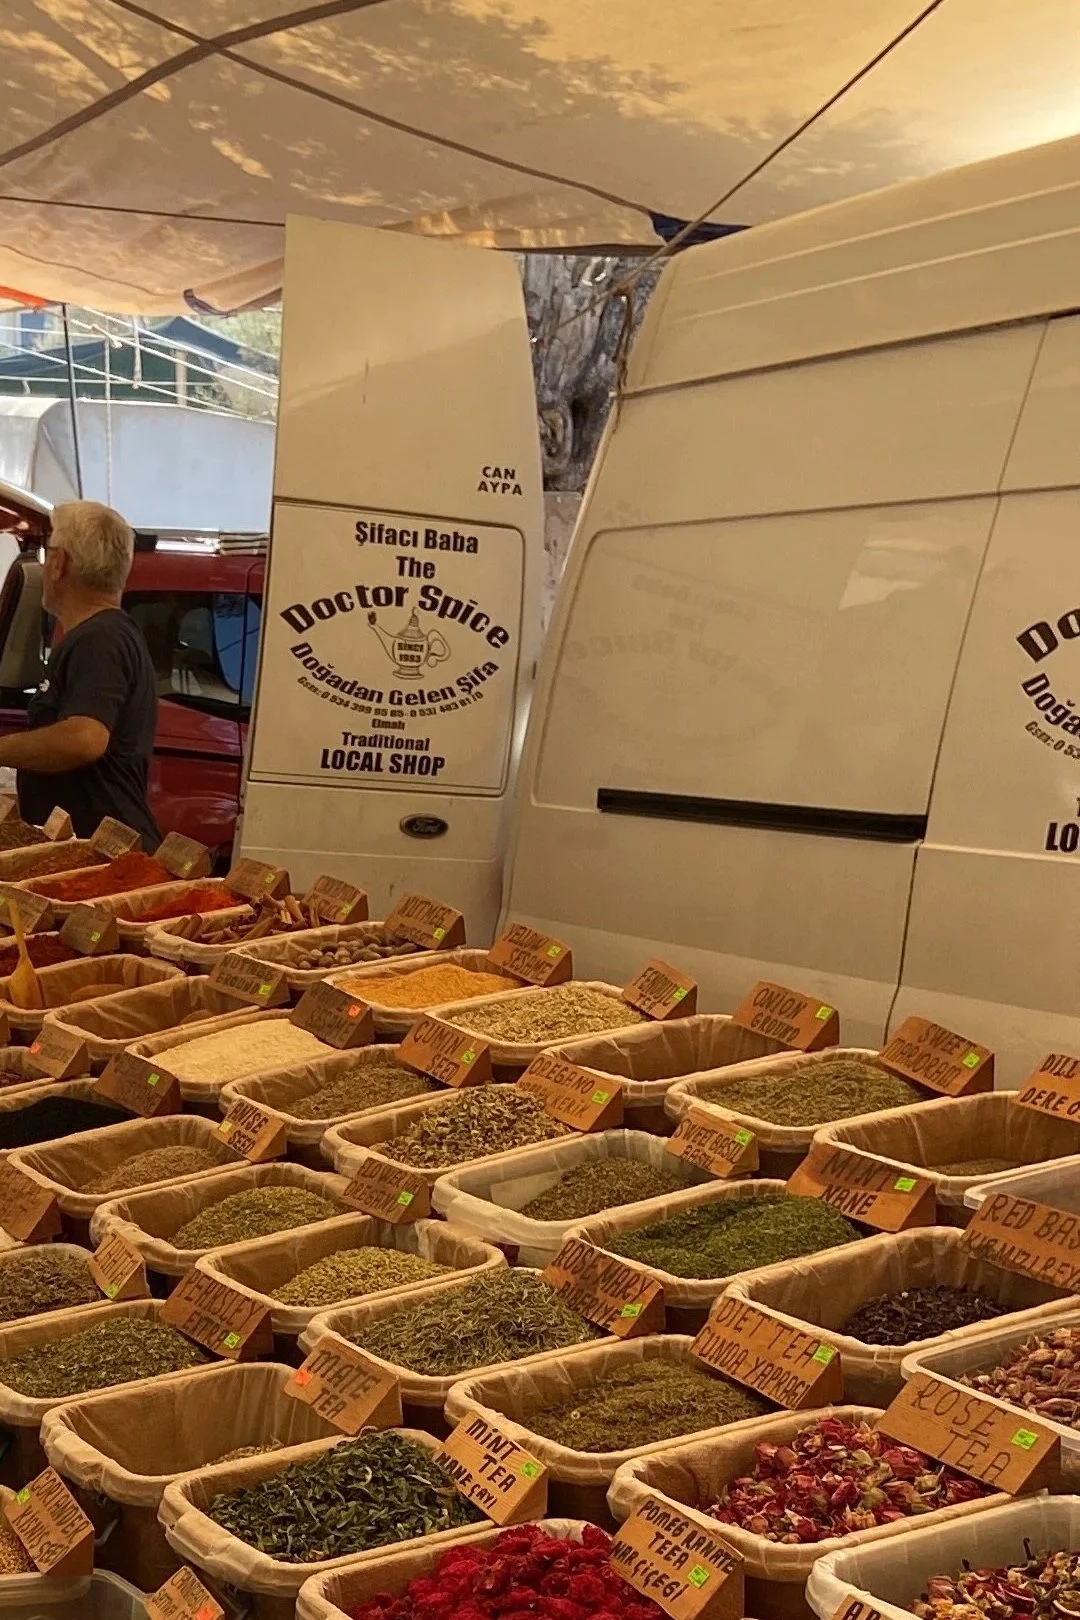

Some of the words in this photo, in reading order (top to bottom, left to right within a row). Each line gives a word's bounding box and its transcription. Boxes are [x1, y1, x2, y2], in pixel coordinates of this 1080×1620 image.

[477, 479, 523, 497] AYPA
[481, 465, 516, 481] CAN
[354, 520, 419, 549] Şifacı
[423, 526, 479, 555] Baba
[395, 556, 436, 580] The
[279, 584, 409, 635] Doctor
[418, 584, 511, 650] Spice
[289, 642, 383, 705] Doğadan
[389, 685, 457, 707] Gelen
[456, 659, 500, 695] Şifa
[342, 731, 431, 753] Traditional
[319, 748, 383, 774] LOCAL
[388, 754, 447, 778] SHOP
[413, 1020, 466, 1057] CUMIN
[916, 1023, 978, 1057] SWEET
[423, 1051, 461, 1083] SEED
[528, 1056, 596, 1095] OREGANO
[1019, 1086, 1069, 1112] DERE
[820, 1183, 880, 1217] NANE
[979, 1192, 1037, 1230] RED
[552, 1240, 600, 1284] ROSE
[592, 1263, 656, 1304] MARY
[715, 1299, 769, 1333] DIET
[766, 1317, 822, 1367] TEA
[306, 1348, 381, 1399] MATE
[310, 1388, 347, 1420] TEA
[909, 1377, 1008, 1438] ROSE
[478, 1453, 517, 1493] TEA
[938, 1429, 1012, 1485] TEA
[433, 1452, 474, 1488] NANE
[467, 1483, 498, 1510] ÇAYI
[30, 1468, 90, 1545] CORIANDER
[609, 1540, 640, 1566] NAR
